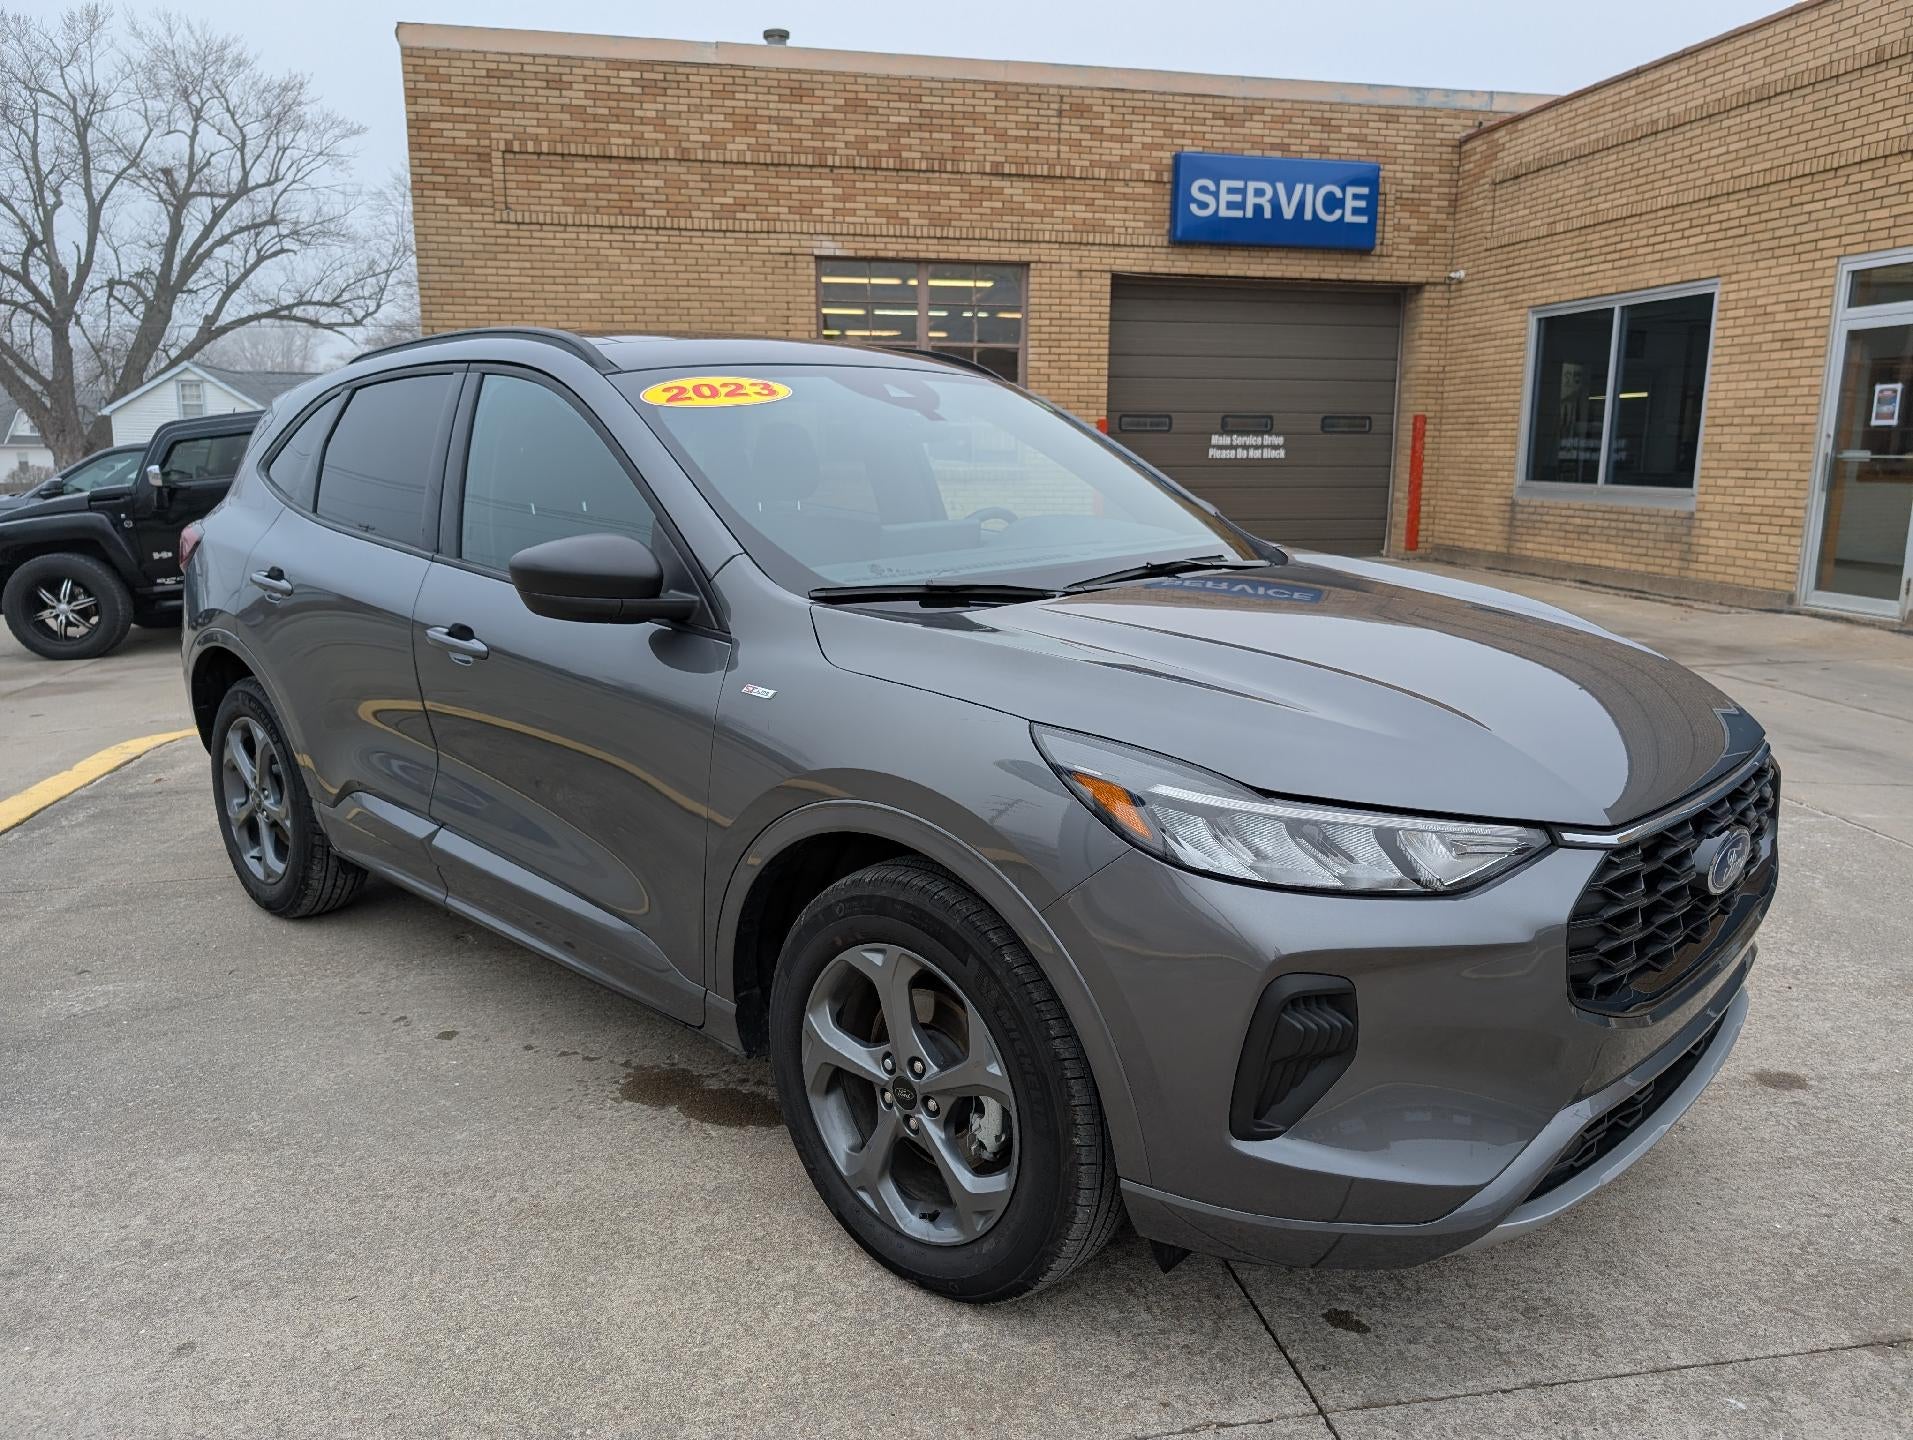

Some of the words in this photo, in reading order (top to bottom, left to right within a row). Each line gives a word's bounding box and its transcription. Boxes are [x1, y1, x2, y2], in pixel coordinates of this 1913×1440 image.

[1189, 178, 1369, 224] SERVICE
[662, 382, 779, 403] 2023
[1211, 434, 1231, 445] Main
[1232, 434, 1261, 445] Service
[1263, 434, 1284, 445] Drive
[1208, 448, 1235, 458] Please
[1236, 448, 1247, 458] Do
[1248, 448, 1261, 458] Not
[1263, 448, 1286, 458] Block
